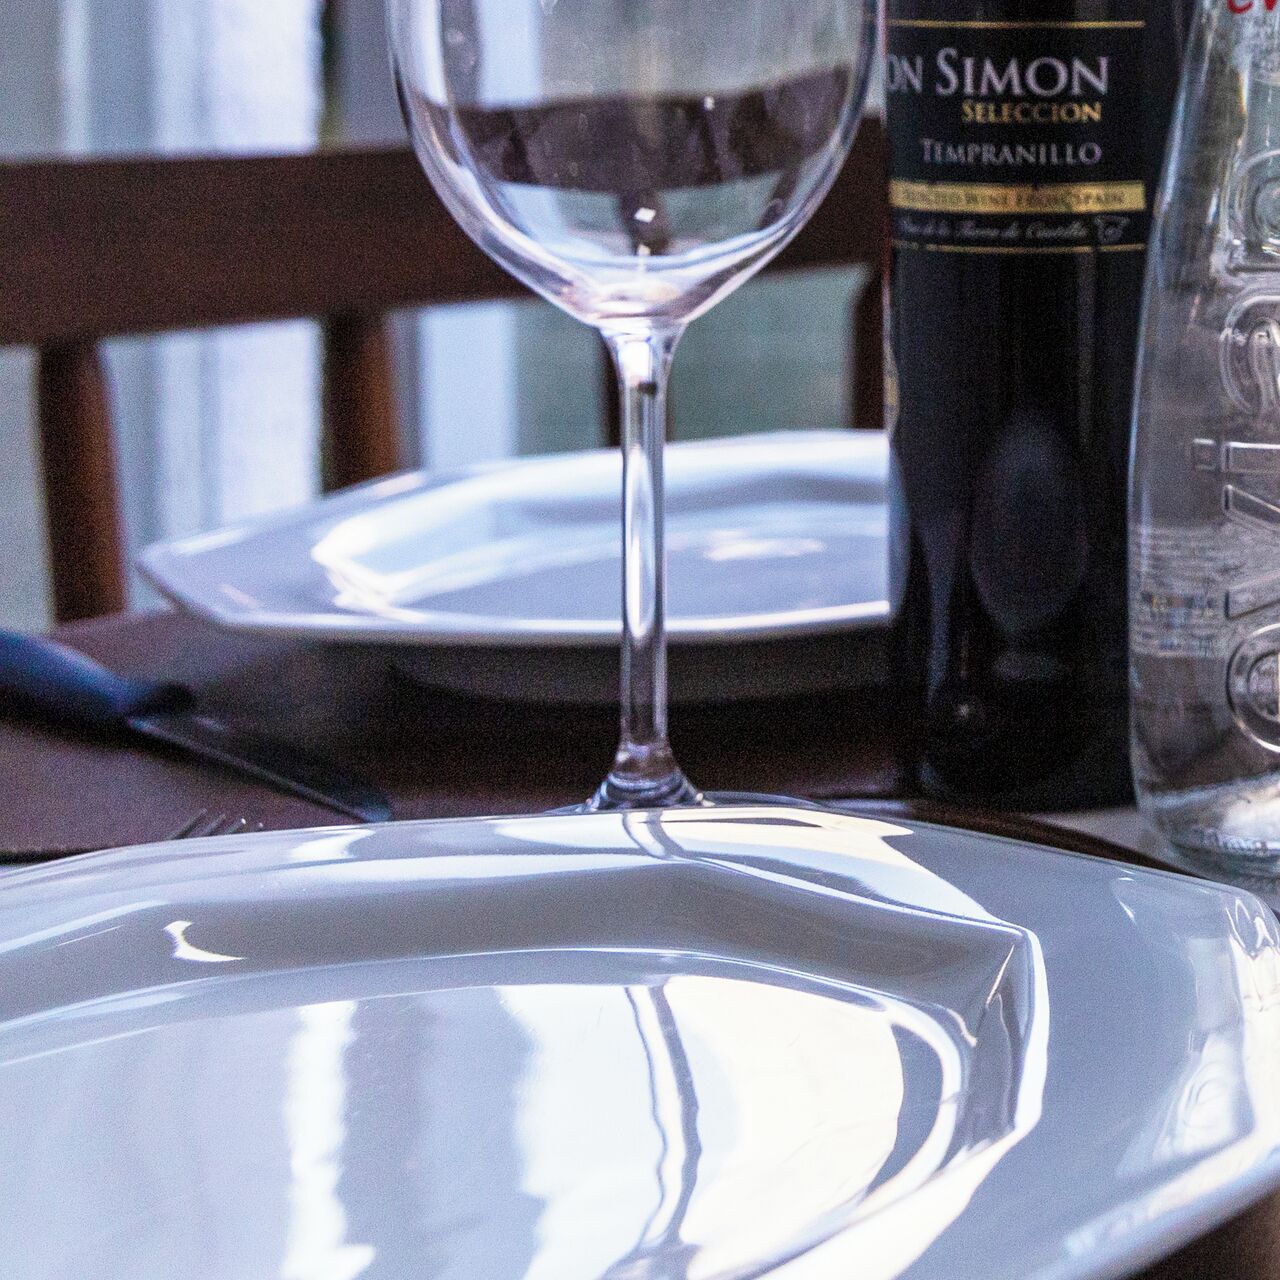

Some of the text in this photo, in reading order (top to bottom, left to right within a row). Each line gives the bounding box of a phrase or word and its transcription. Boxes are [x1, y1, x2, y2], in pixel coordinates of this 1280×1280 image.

[886, 47, 1109, 96] ON SIMON
[962, 98, 1101, 124] SELECCION
[921, 137, 1102, 166] TEMPRANILLO
